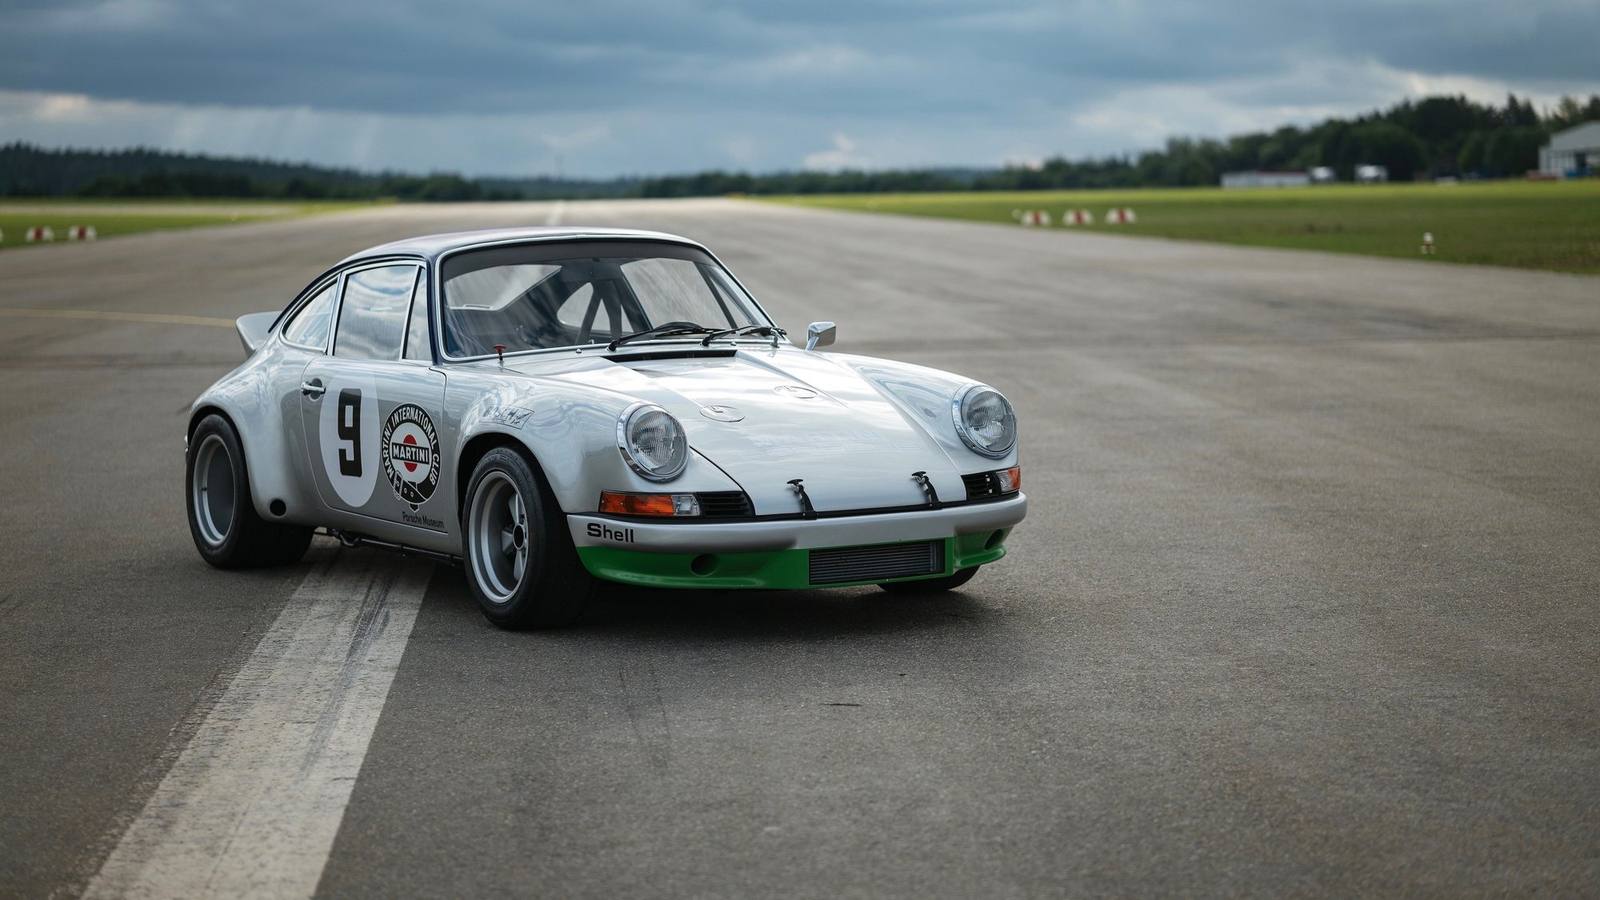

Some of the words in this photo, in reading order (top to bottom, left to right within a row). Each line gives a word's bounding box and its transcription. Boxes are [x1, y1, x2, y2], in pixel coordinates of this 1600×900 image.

[338, 388, 362, 477] 9
[382, 425, 395, 480] MARTINI
[391, 406, 435, 450] INTERNATIONAL
[429, 453, 440, 486] CLUB
[393, 445, 429, 463] MARTINI
[402, 511, 422, 525] Porsche
[422, 515, 444, 528] Museum
[587, 522, 634, 543] Shell
